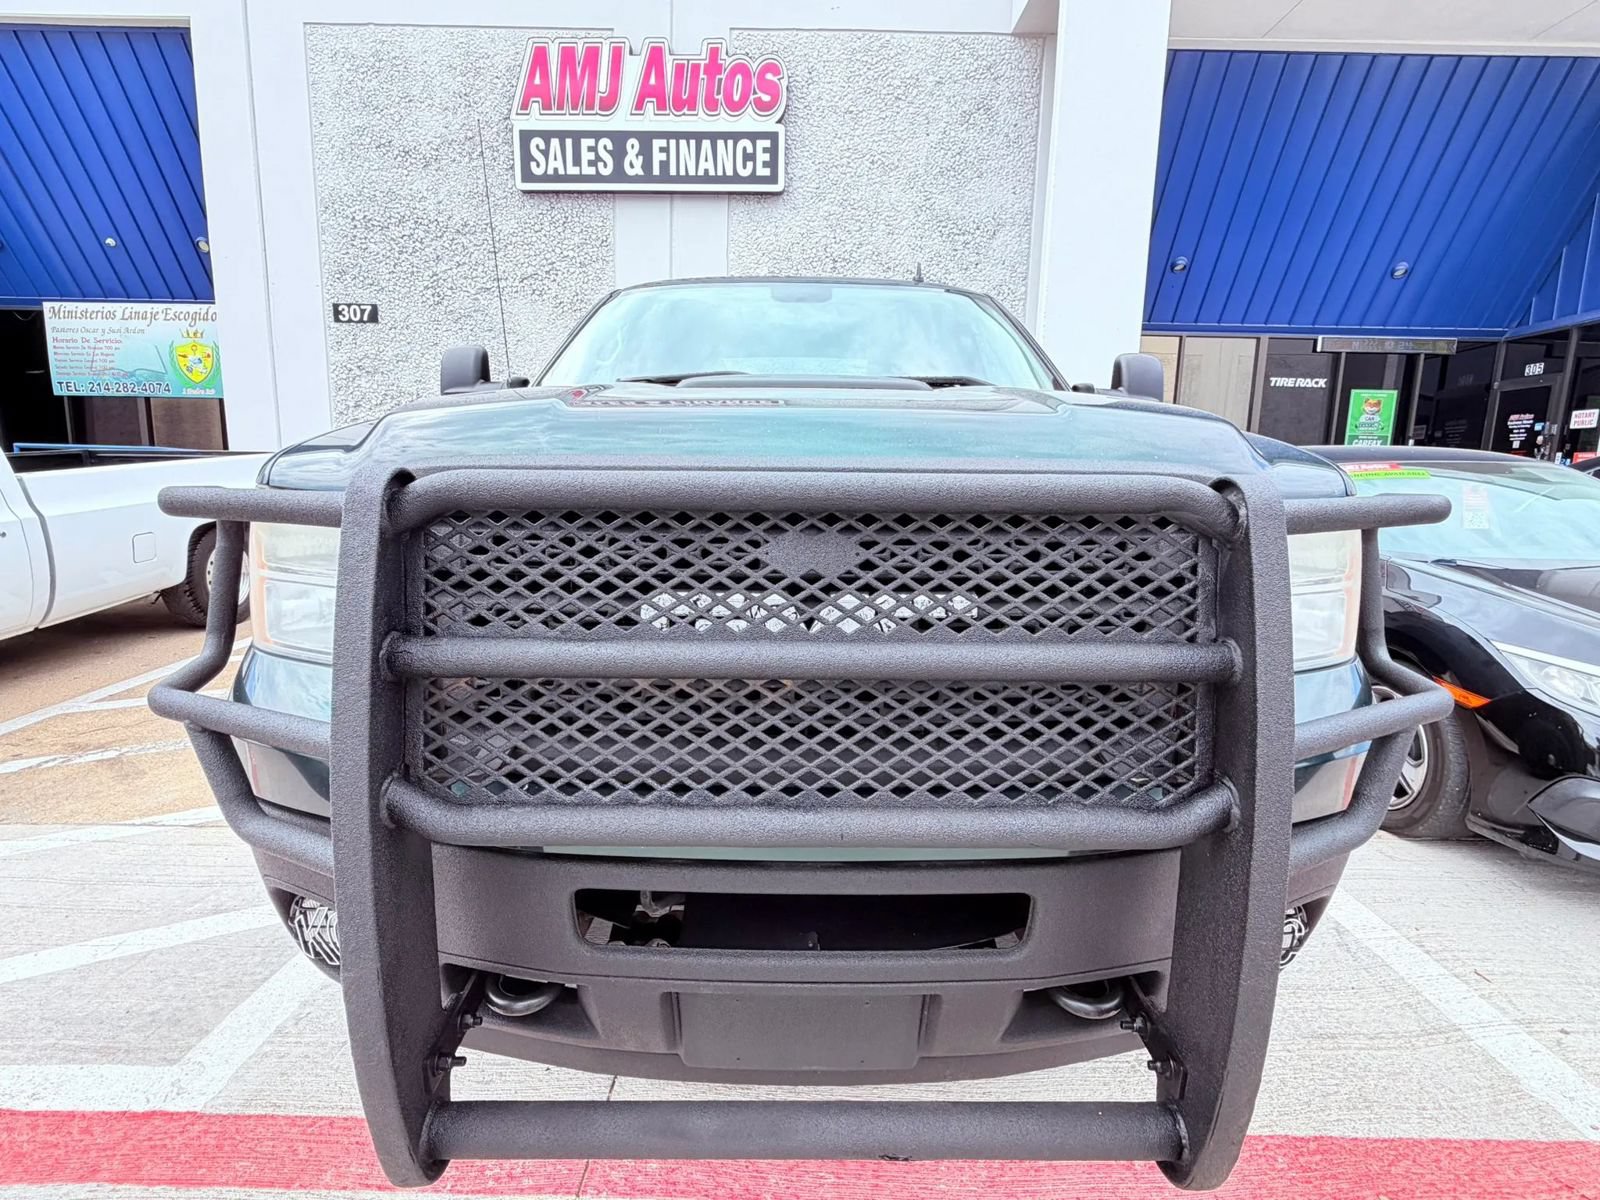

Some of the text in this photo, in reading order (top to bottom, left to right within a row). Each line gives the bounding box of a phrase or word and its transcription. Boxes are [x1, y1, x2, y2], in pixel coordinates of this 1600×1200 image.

[517, 43, 783, 115] AMJ Autos
[529, 137, 771, 177] SALES & FINANCE
[48, 304, 217, 327] Ministerios Linaje Escogido
[338, 304, 372, 321] 307
[52, 336, 79, 344] Horario
[81, 336, 91, 344] De
[1526, 363, 1543, 376] 305
[57, 381, 85, 392] TEL:
[88, 382, 171, 393] 214-282-4074
[1269, 377, 1328, 388] TIRE RACK
